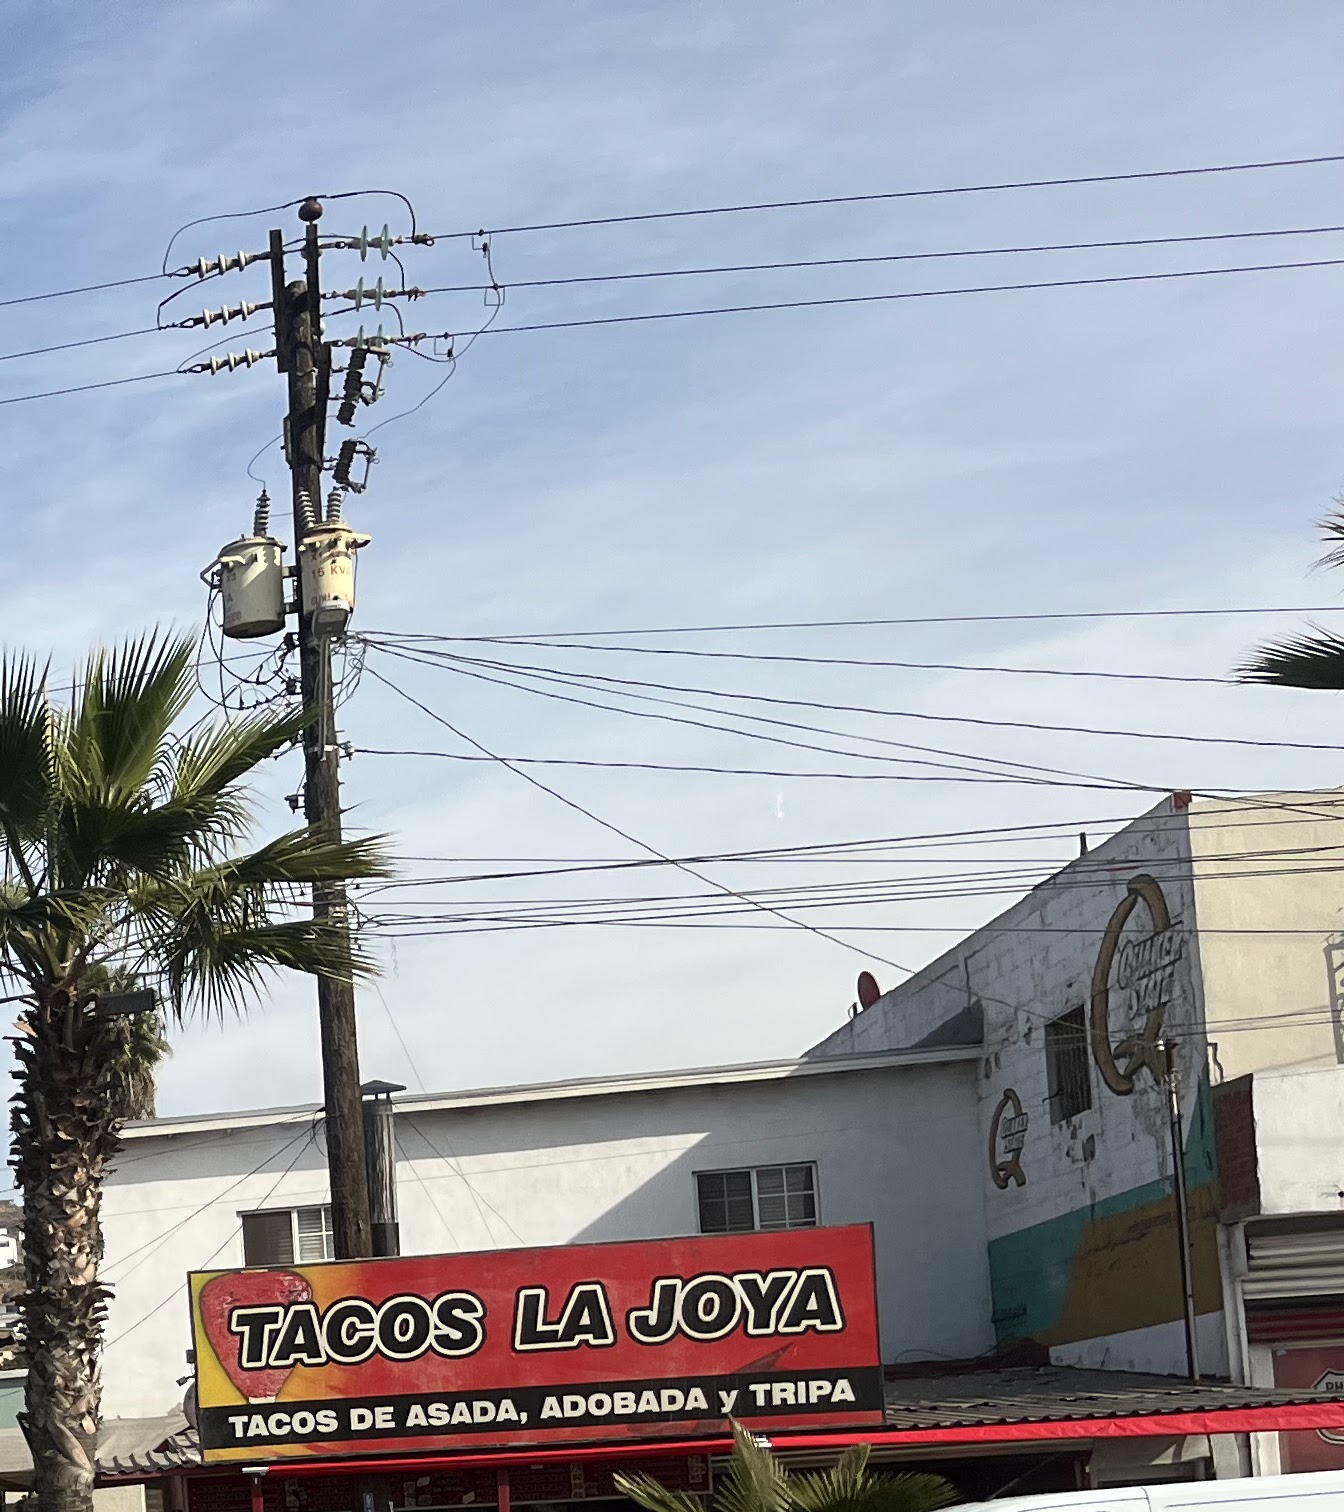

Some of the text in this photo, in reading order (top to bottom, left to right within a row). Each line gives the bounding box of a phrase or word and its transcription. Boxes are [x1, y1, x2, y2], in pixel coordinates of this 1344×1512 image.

[232, 1268, 843, 1368] TACOS LA JOYA
[228, 1378, 856, 1438] TACOS DE ASADA, ADOBADA y TRIPA
